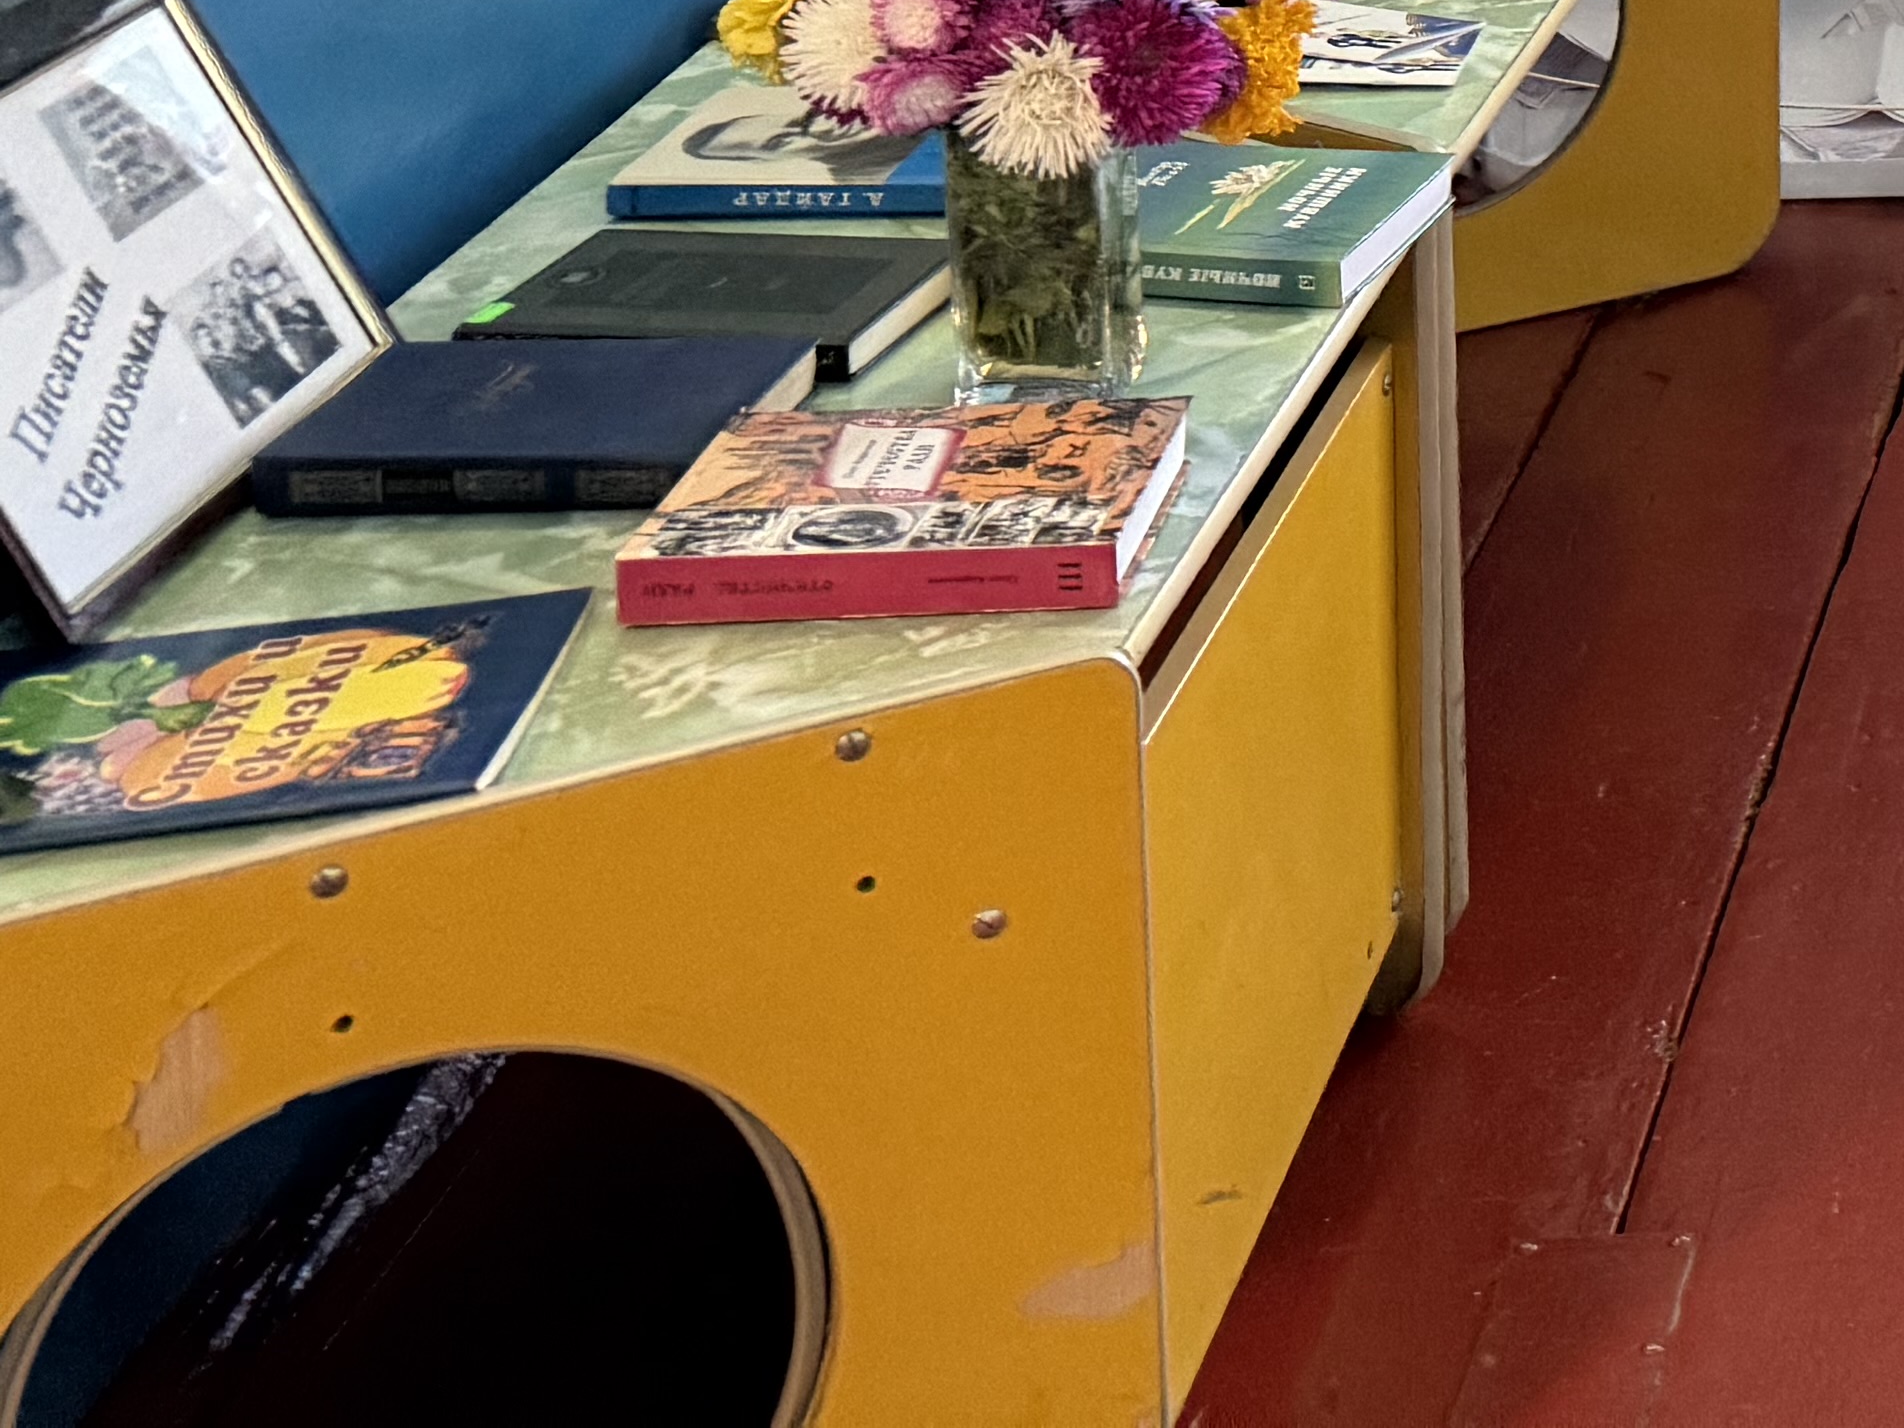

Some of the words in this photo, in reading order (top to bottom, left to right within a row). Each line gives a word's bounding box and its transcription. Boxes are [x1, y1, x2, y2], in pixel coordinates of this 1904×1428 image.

[732, 188, 853, 210] ГАЙДАР
[1276, 166, 1343, 212] НОЧНЫЕ
[1282, 167, 1368, 229] КУВШИНКИ
[1188, 267, 1282, 289] НОЧНЫЕ
[9, 265, 109, 464] Писатели
[125, 673, 278, 811] Стихи
[251, 636, 303, 662] и
[231, 642, 368, 784] сказки
